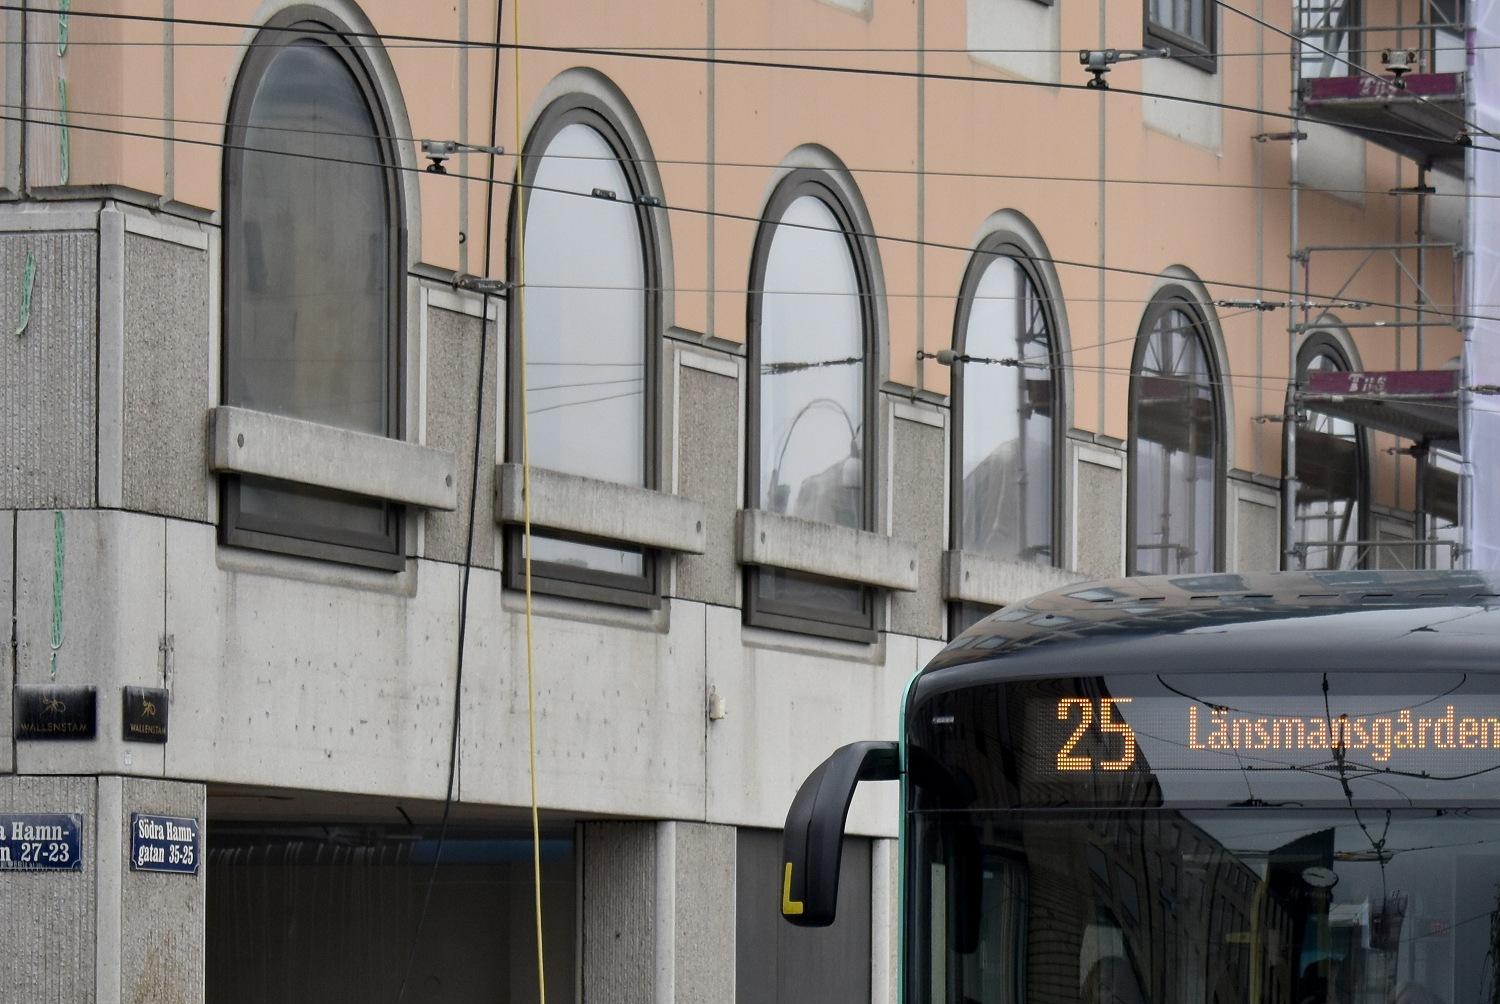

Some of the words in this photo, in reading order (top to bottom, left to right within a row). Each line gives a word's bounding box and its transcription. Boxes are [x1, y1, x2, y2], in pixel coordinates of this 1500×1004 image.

[1056, 697, 1135, 771] 25
[12, 821, 69, 841] Hamn-
[138, 818, 164, 840] Södra
[166, 823, 195, 842] Hamn-
[21, 842, 69, 862] 27-23
[138, 846, 165, 866] gatan
[168, 844, 194, 865] 35-25
